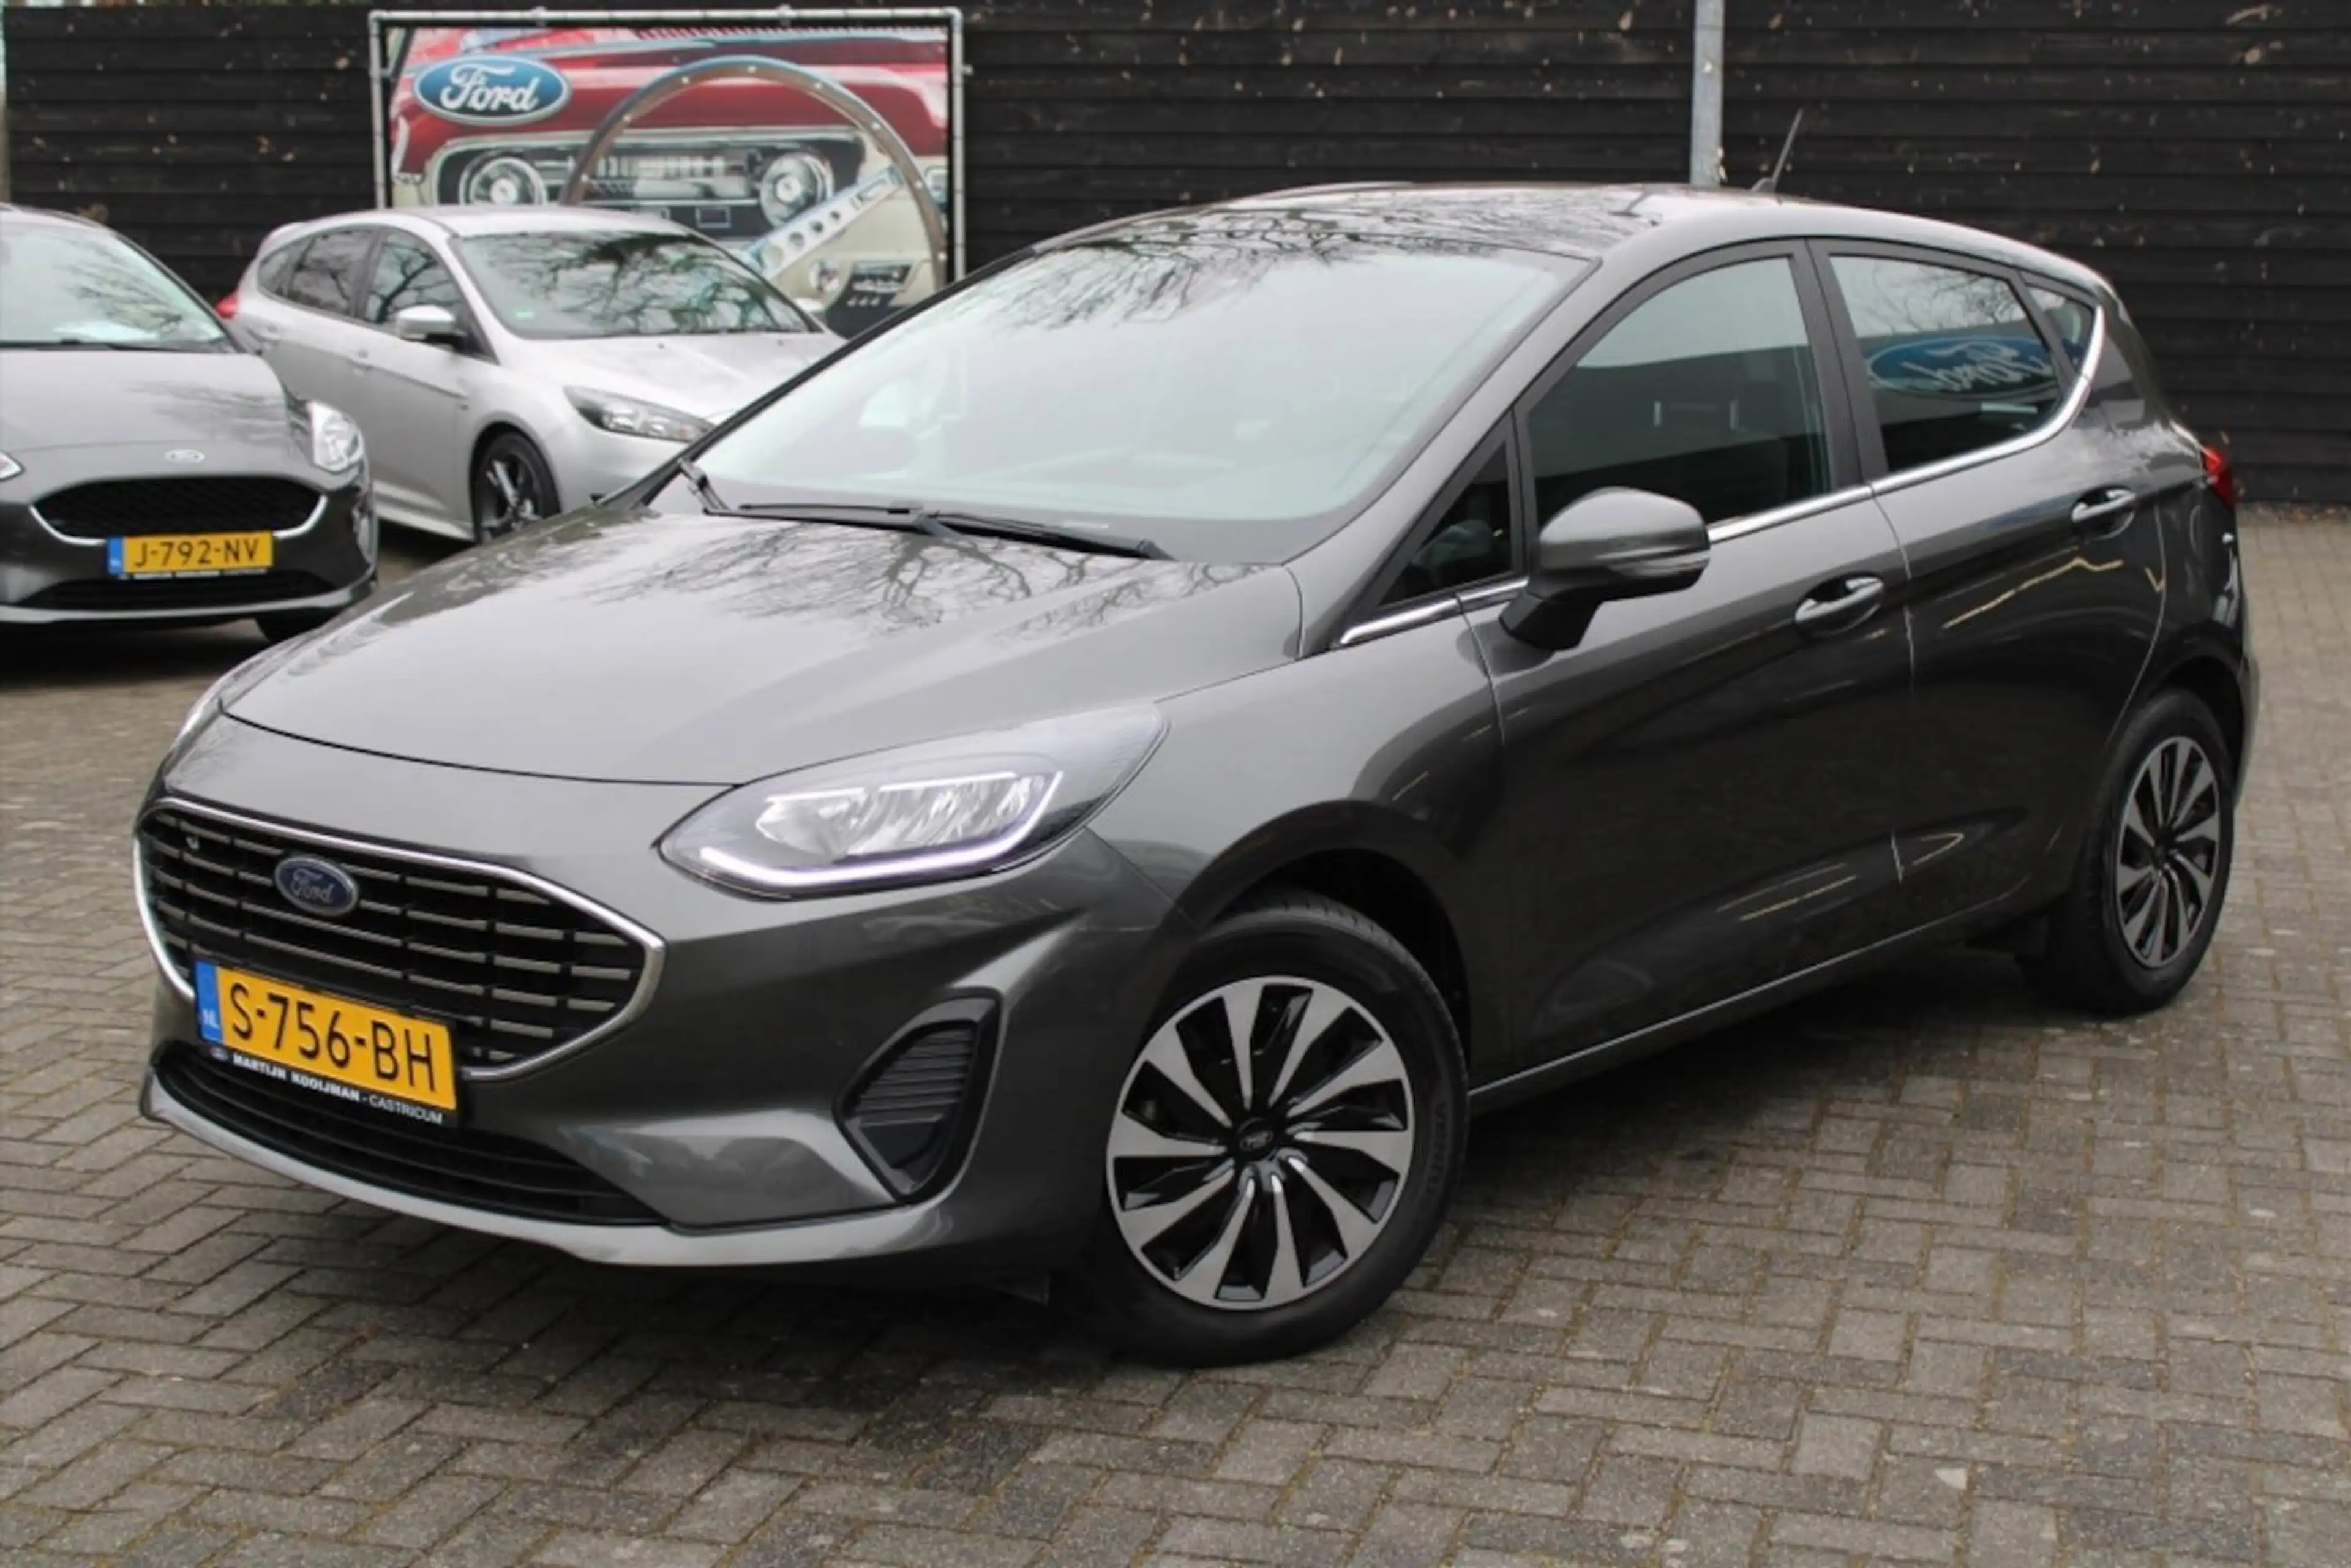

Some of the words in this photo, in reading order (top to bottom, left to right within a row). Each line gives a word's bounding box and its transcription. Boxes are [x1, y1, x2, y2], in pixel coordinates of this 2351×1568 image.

[439, 62, 540, 111] Ford
[134, 538, 260, 568] J-792-NV
[290, 868, 336, 905] Ford
[230, 982, 436, 1092] S-756-BH
